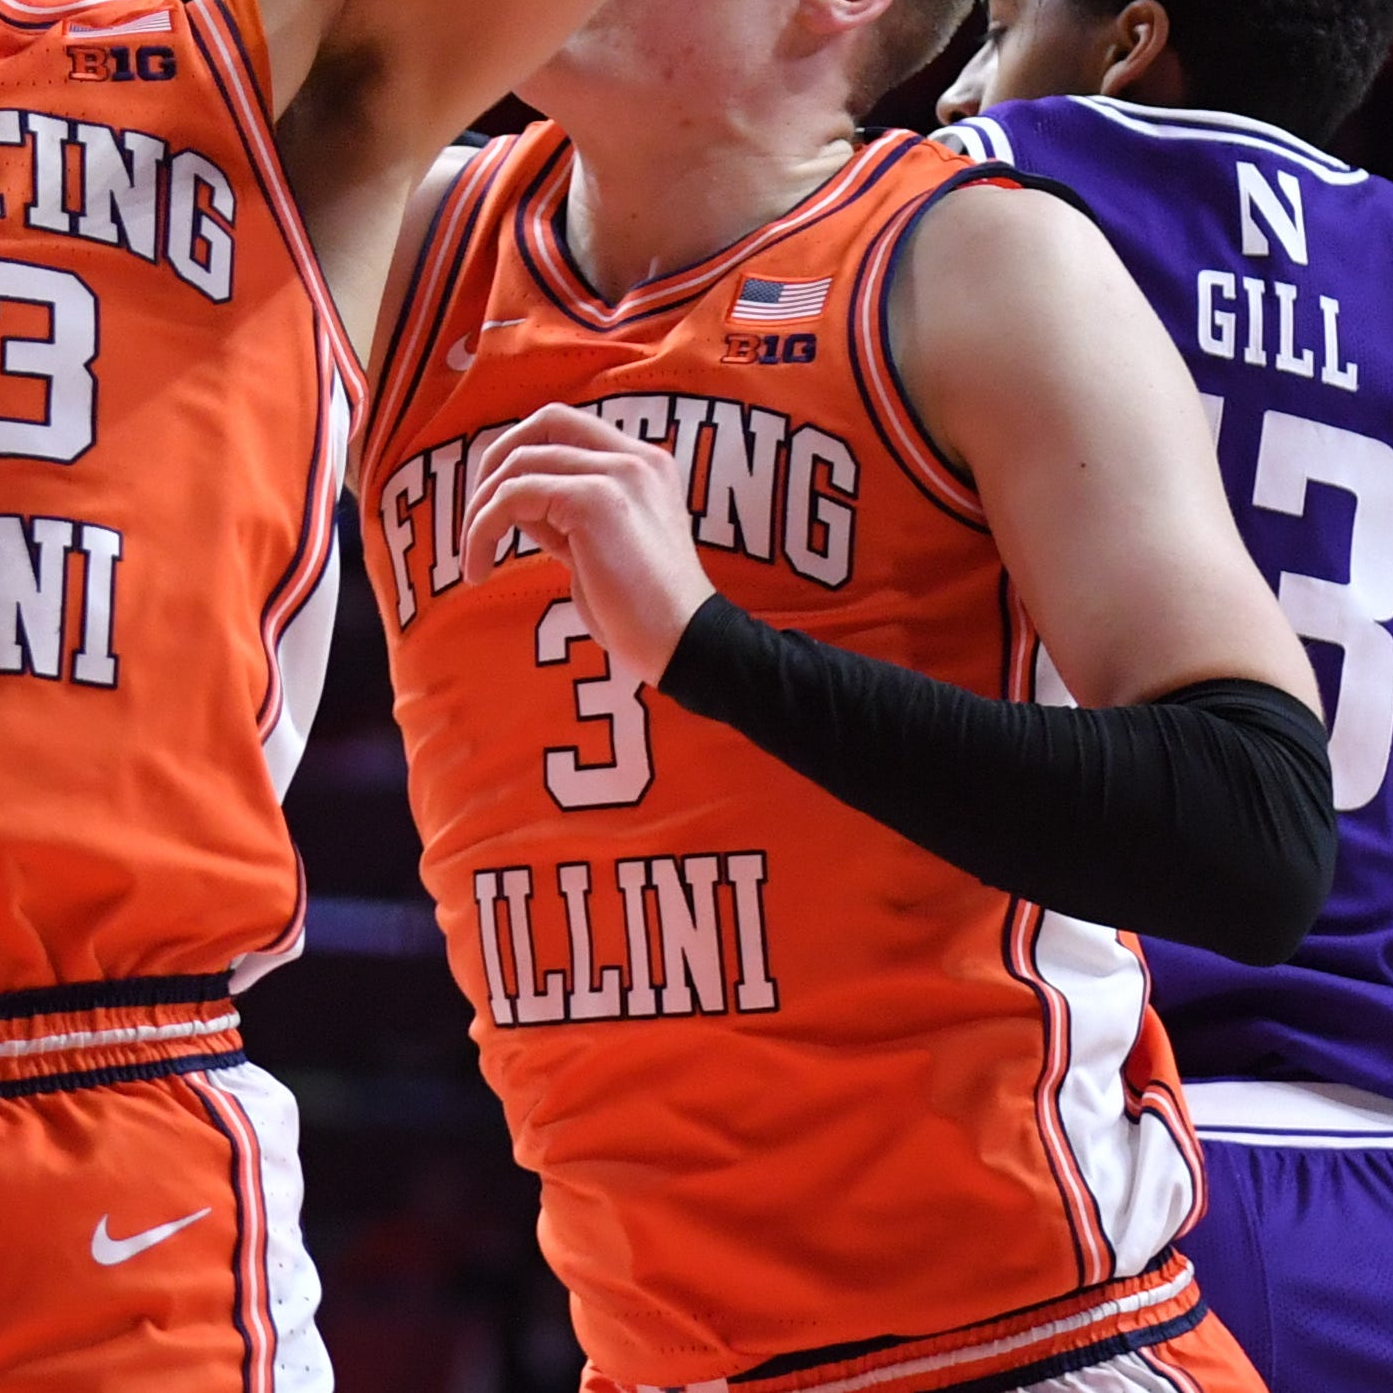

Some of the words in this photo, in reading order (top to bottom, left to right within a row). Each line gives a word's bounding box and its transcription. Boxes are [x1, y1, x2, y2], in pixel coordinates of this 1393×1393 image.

[1236, 160, 1308, 266] N
[1197, 269, 1359, 392] GILL
[380, 391, 860, 631] FIING
[534, 597, 654, 811] 3
[473, 849, 780, 1028] ILLINI
